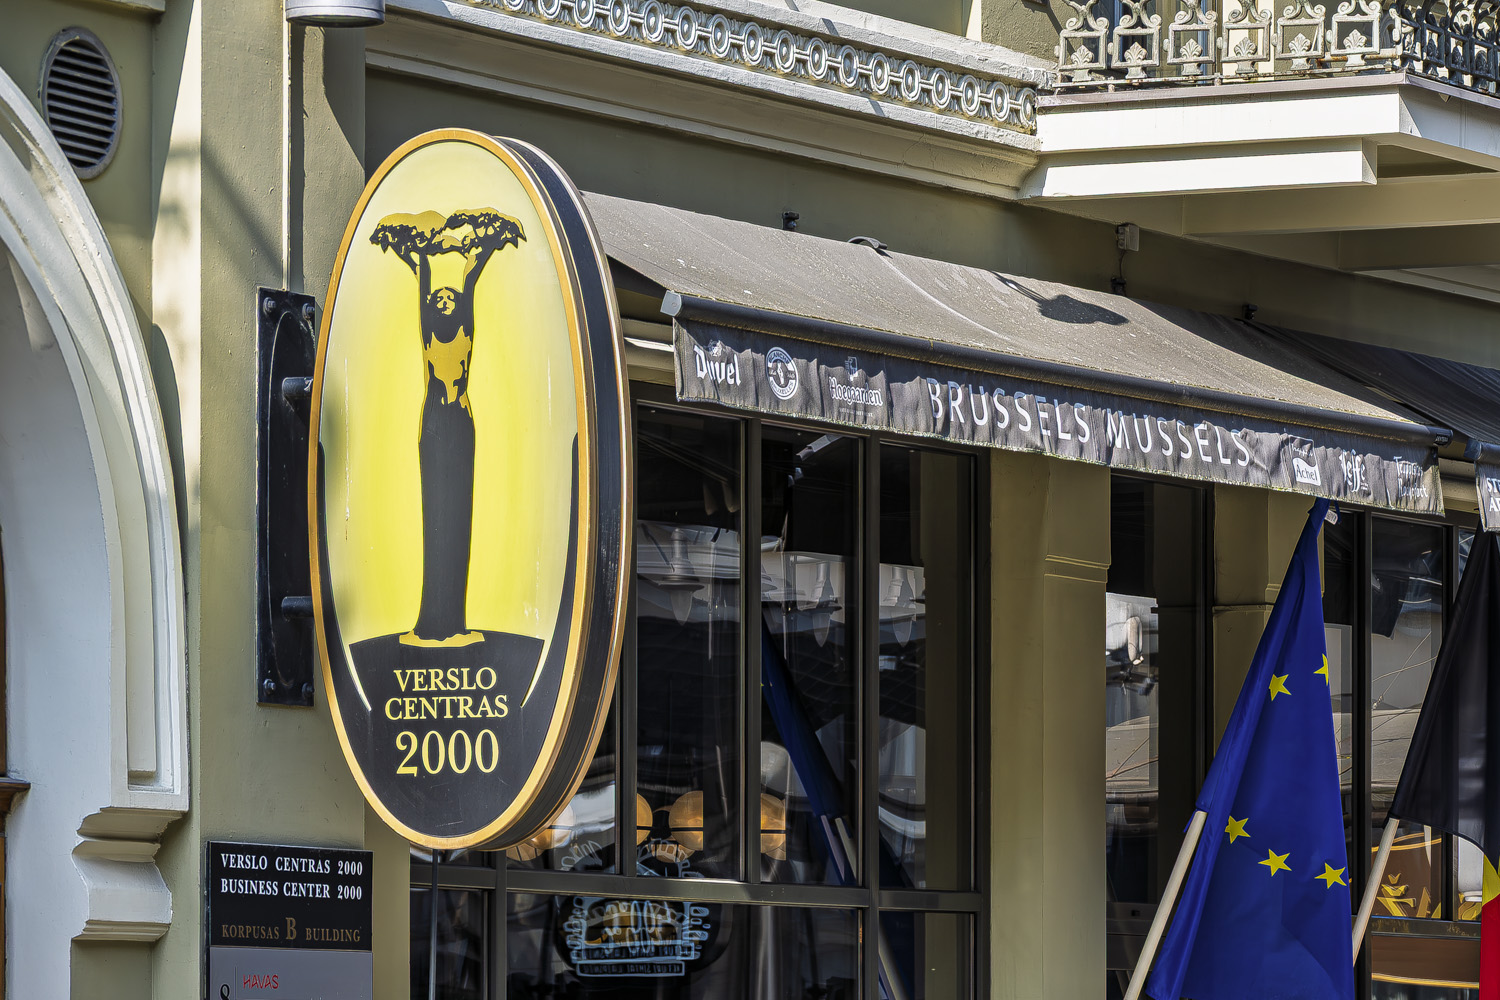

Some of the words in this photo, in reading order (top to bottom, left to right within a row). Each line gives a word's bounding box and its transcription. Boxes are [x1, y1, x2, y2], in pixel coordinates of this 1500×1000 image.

[694, 345, 741, 386] Duvel
[828, 376, 884, 407] Hoegaarden
[925, 377, 1092, 443] BRUSSELS
[1106, 408, 1250, 467] MUSSELS
[1296, 464, 1317, 482] Achel
[394, 667, 496, 692] VERSLO
[385, 694, 509, 720] CENTRAS
[396, 728, 499, 777] 2000
[220, 853, 268, 870] VERSLO
[275, 857, 331, 874] CENTRAS
[338, 860, 363, 876] 2000
[220, 878, 279, 896] BUSINESS
[283, 882, 330, 899] CENTER
[338, 885, 362, 900] 2000
[222, 924, 280, 940] KORPUSAS
[285, 917, 297, 940] B
[305, 927, 361, 943] BUILDING
[242, 974, 279, 989] HAVAS
